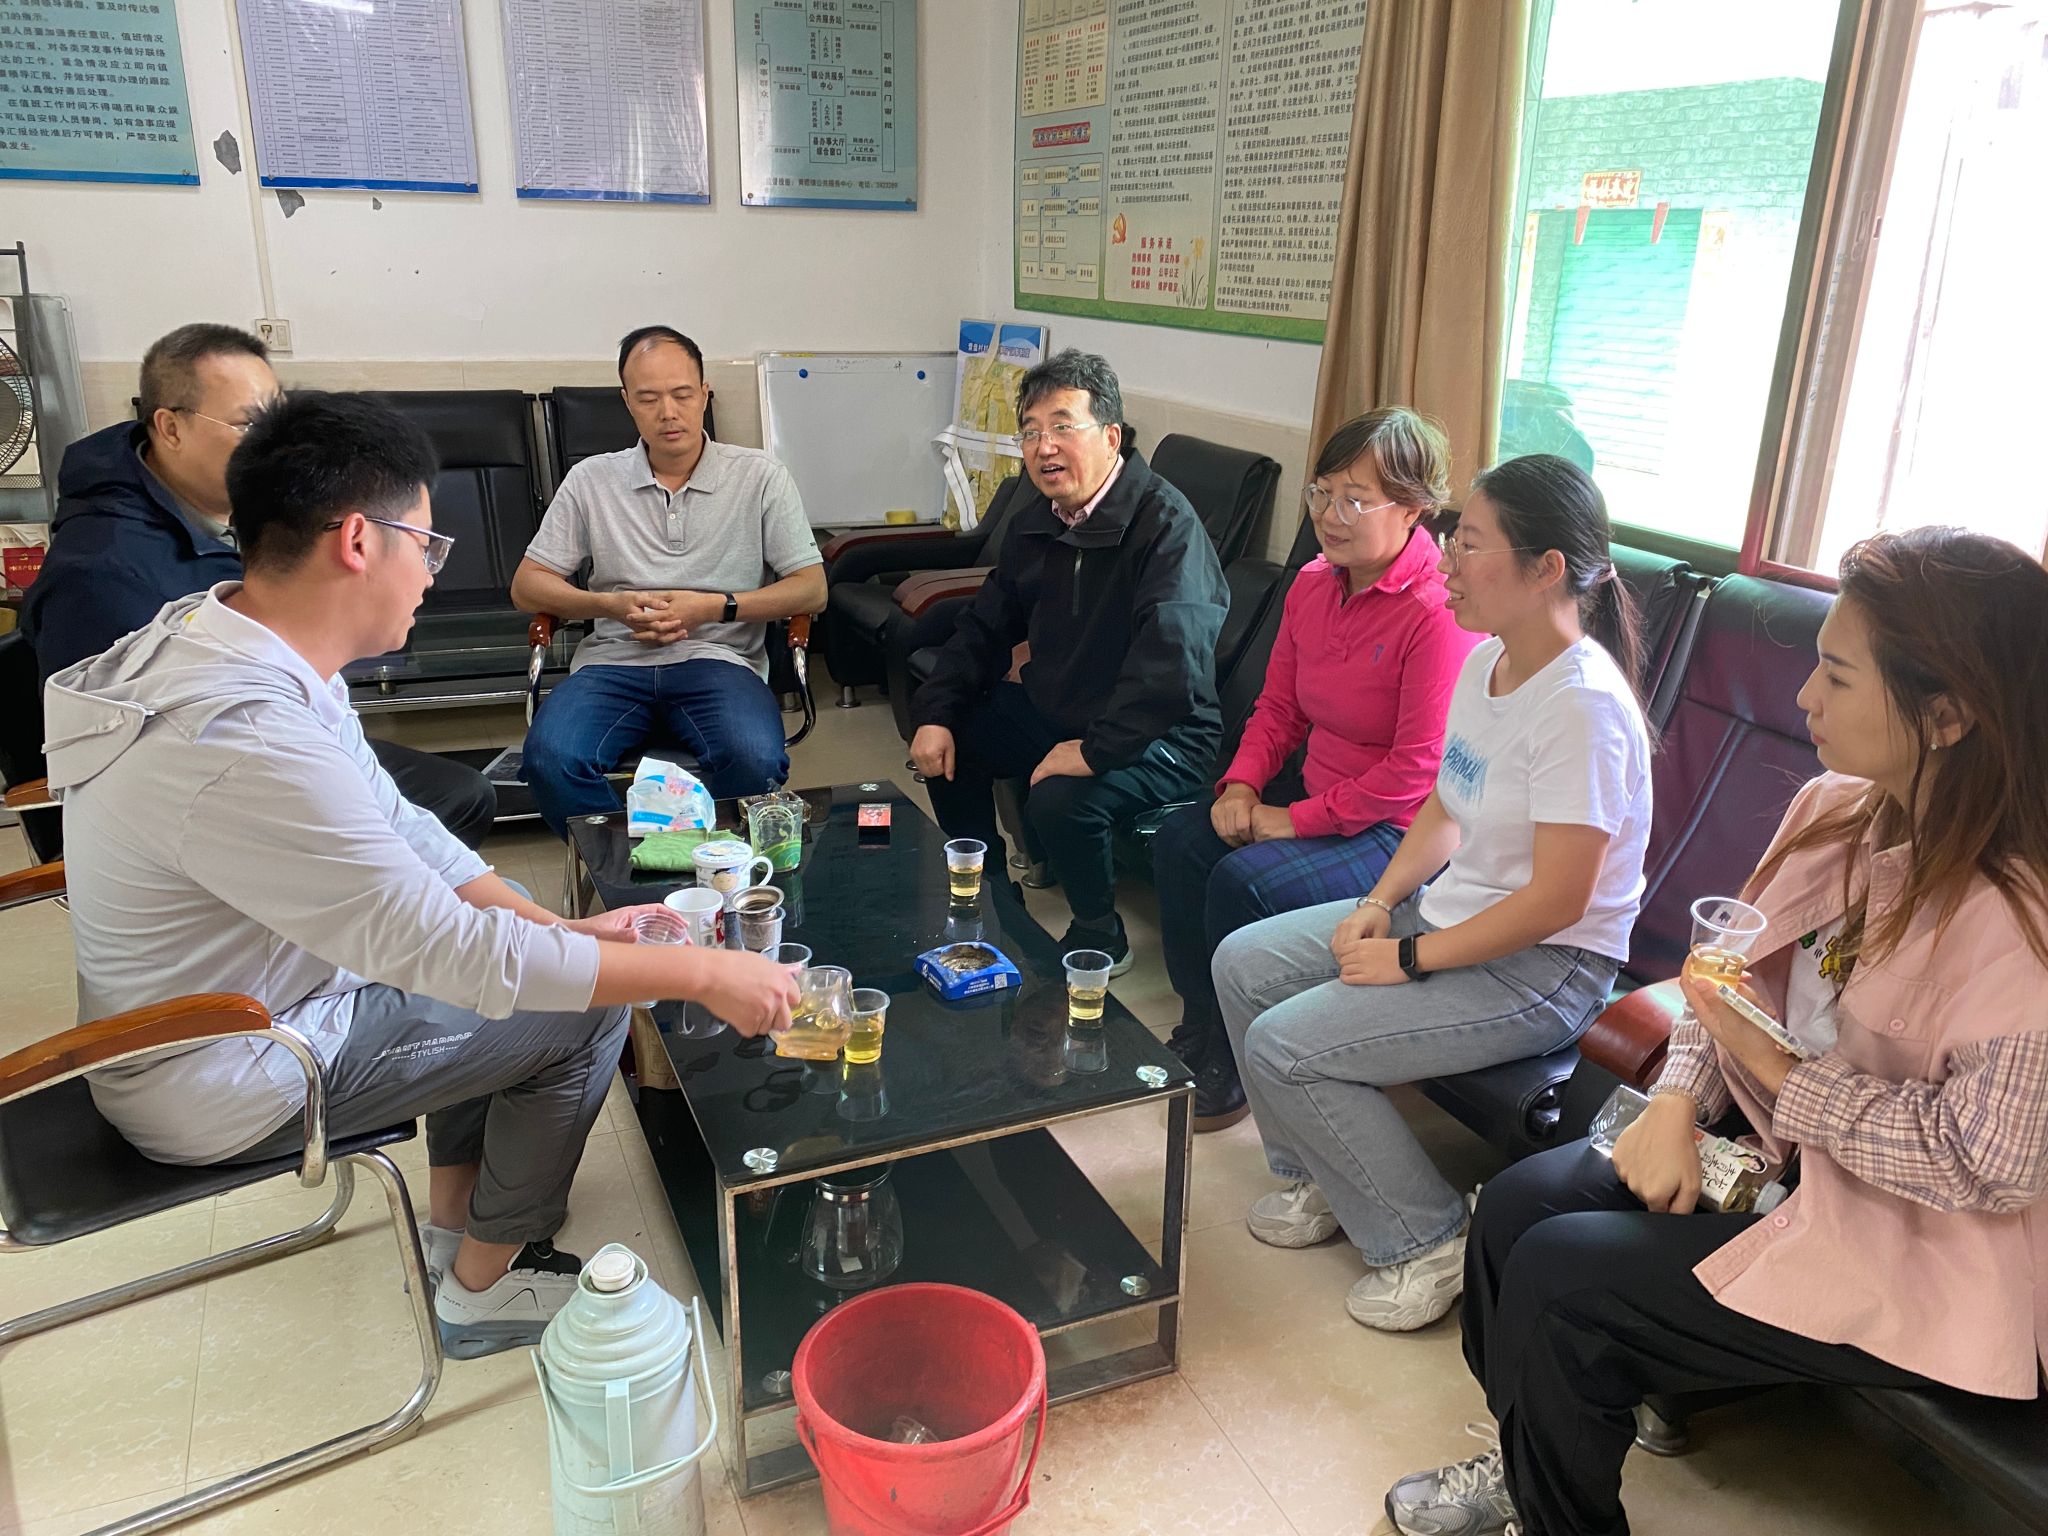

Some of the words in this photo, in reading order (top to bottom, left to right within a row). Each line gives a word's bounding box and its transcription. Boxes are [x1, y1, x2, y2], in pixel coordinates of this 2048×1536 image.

[0, 41, 166, 57] 导汇报，对各类突发事件做好联络
